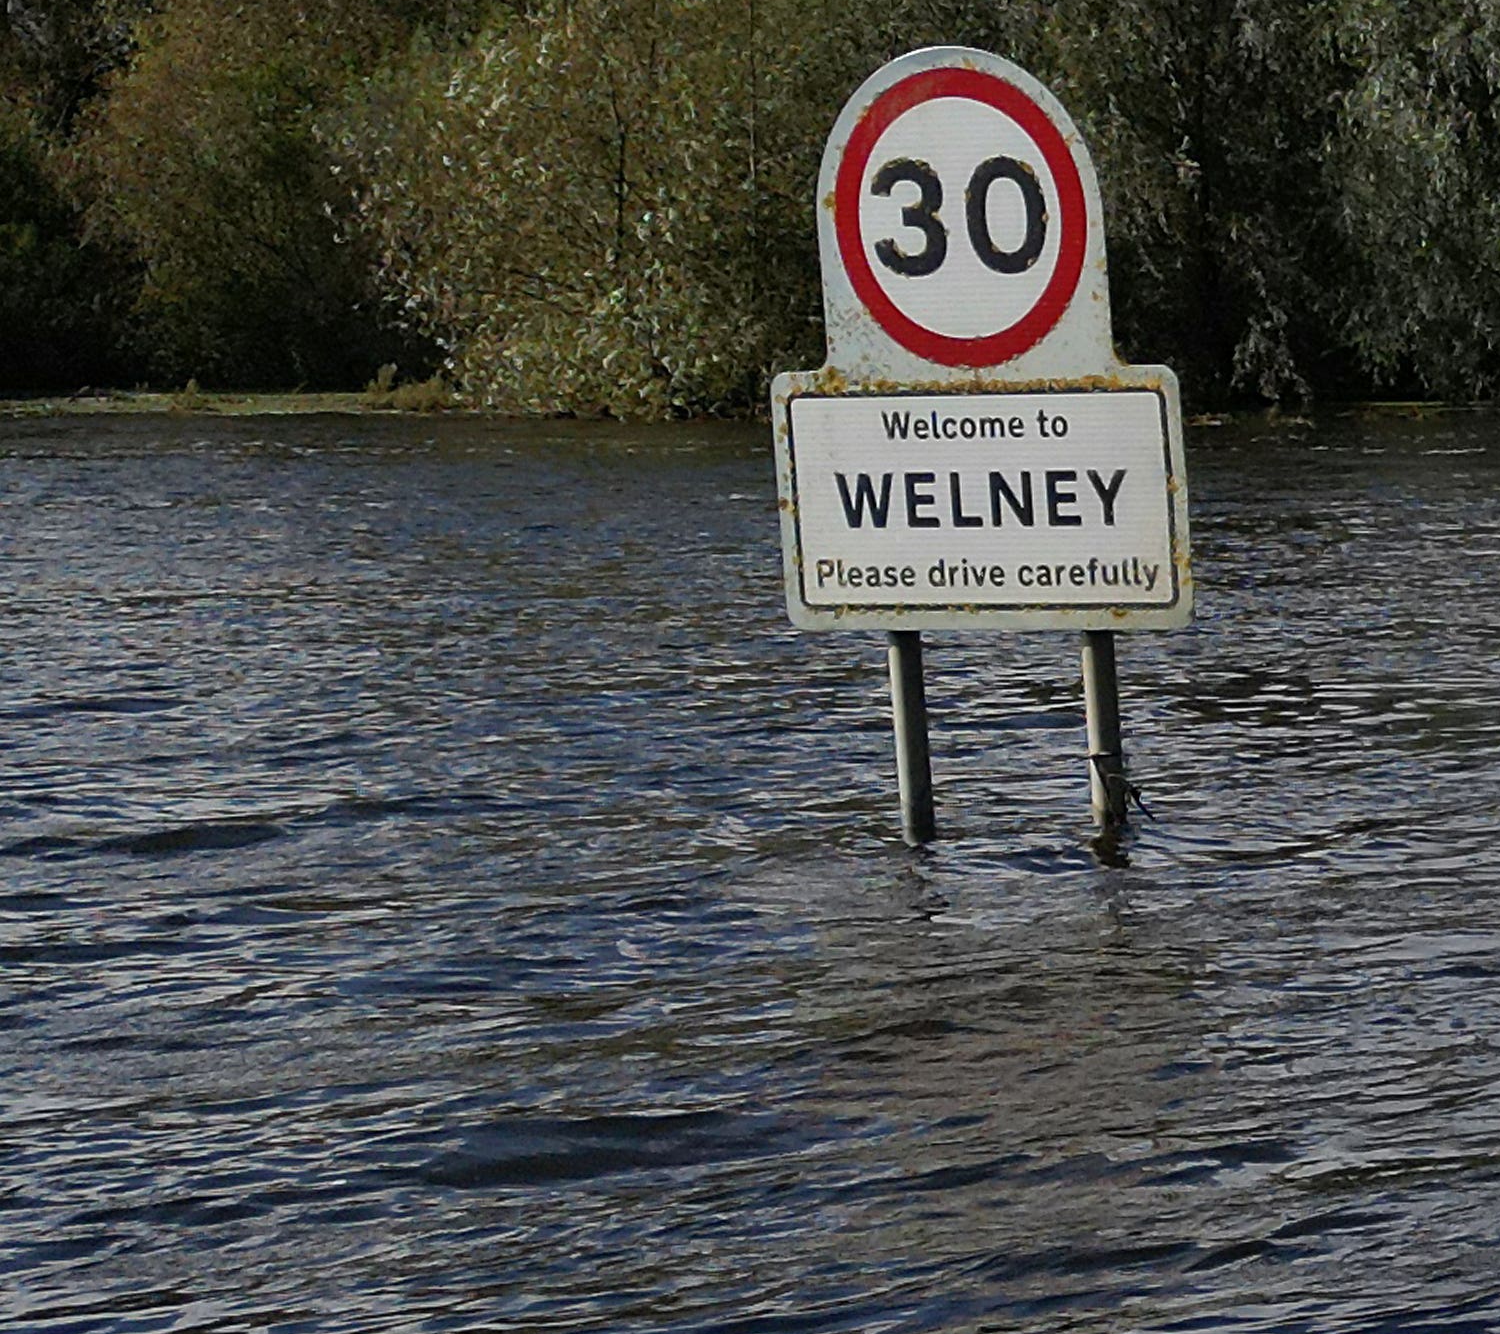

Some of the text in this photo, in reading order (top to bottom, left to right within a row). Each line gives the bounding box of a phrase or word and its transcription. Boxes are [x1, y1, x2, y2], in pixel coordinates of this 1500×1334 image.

[870, 156, 1048, 277] 30
[882, 410, 1069, 440] Welcome to
[834, 469, 1127, 529] WELNEY
[816, 557, 1159, 591] Please drive carefully
